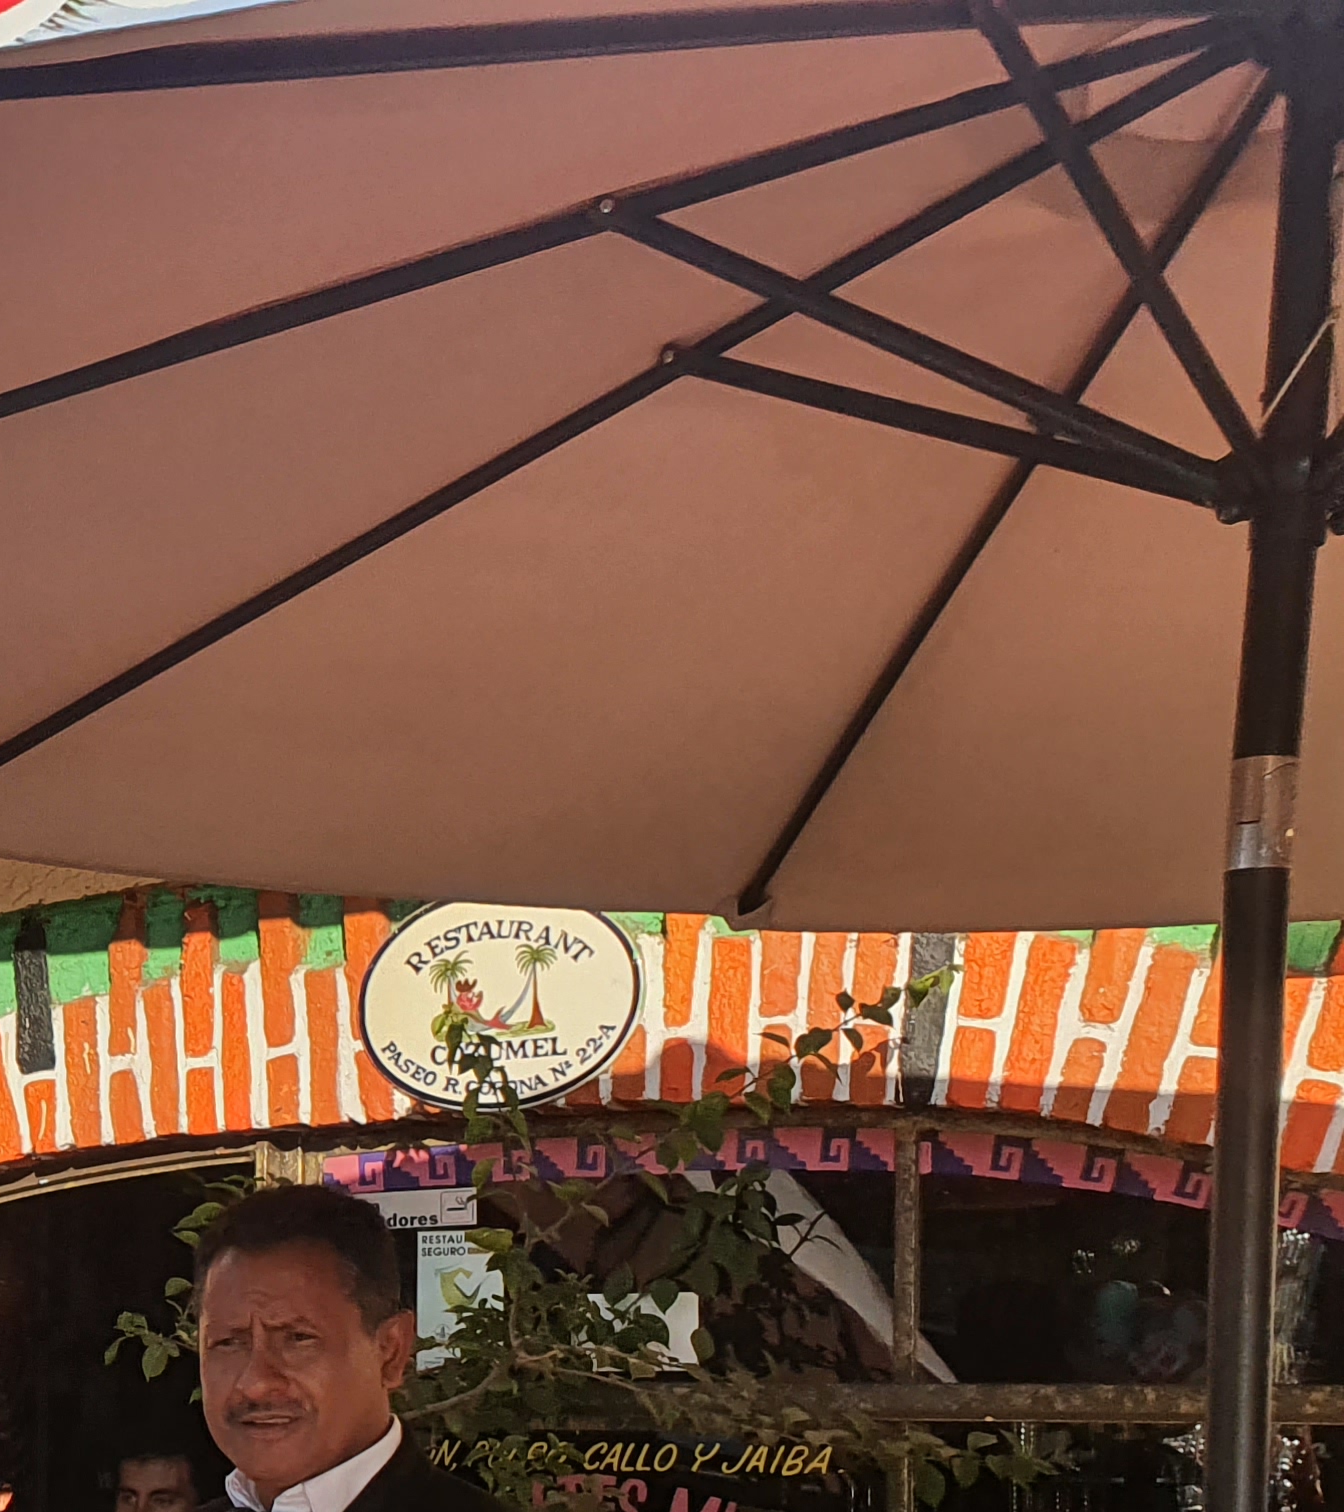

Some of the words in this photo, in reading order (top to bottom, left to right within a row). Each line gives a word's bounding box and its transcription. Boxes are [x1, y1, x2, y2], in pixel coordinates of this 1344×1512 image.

[404, 919, 595, 975] RESTAURANT
[380, 1041, 438, 1086] PASEO
[442, 1075, 463, 1095] R.
[465, 1074, 549, 1098] CORONA
[575, 1022, 617, 1065] 22-A
[421, 1235, 467, 1245] RESTAU
[421, 1247, 467, 1257] SEGURO
[583, 1441, 679, 1472] CALLO
[691, 1442, 722, 1473] Y
